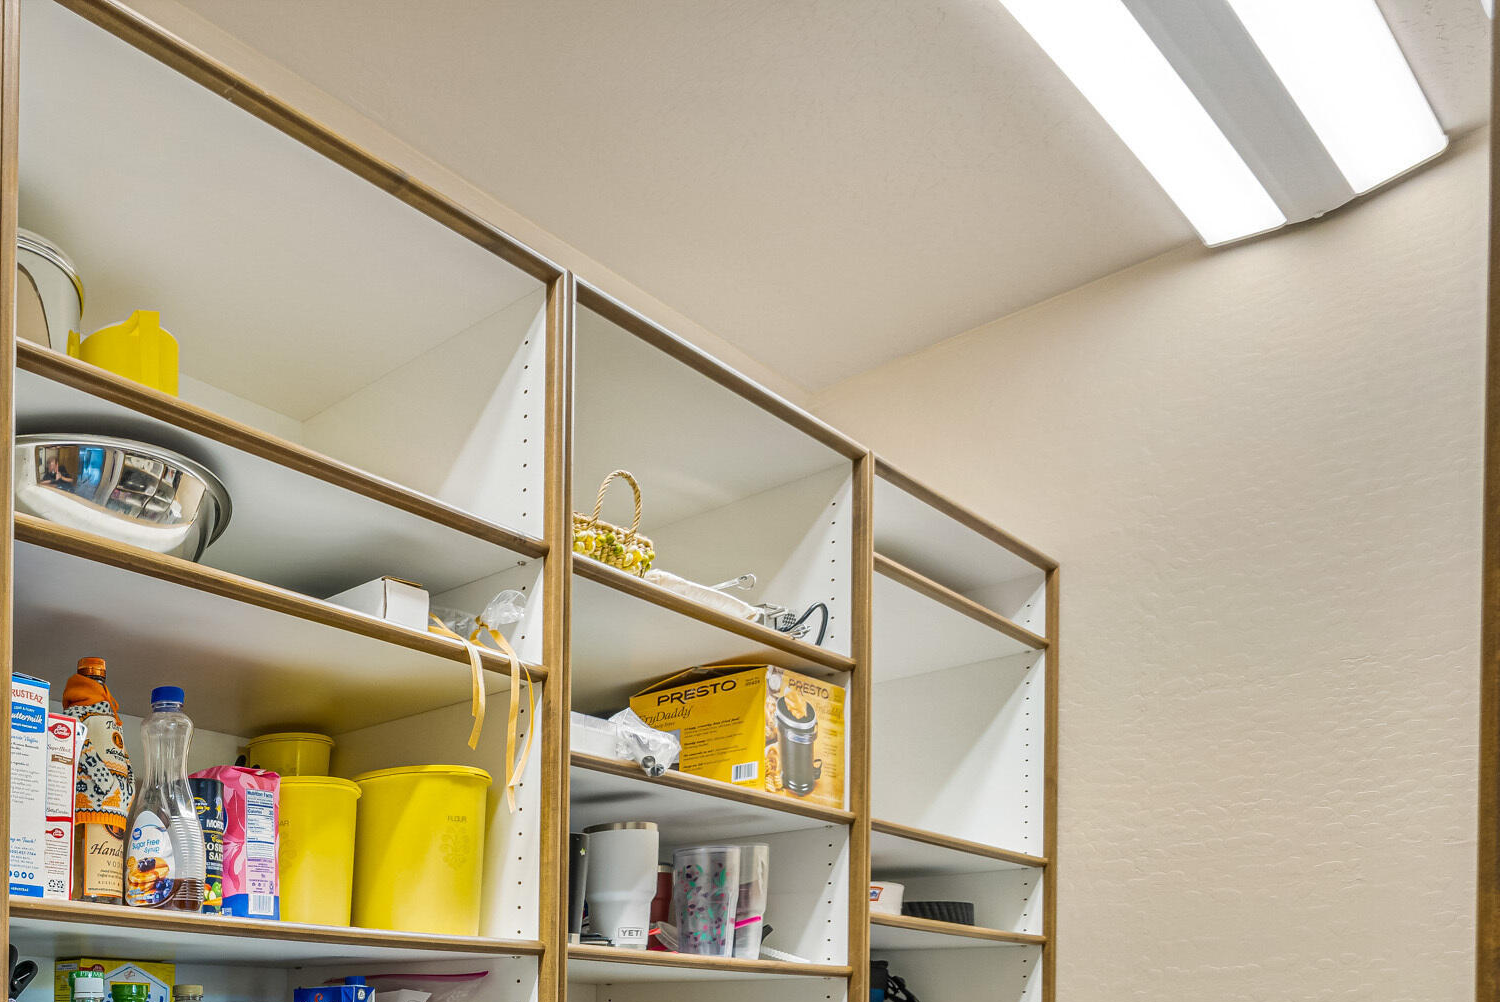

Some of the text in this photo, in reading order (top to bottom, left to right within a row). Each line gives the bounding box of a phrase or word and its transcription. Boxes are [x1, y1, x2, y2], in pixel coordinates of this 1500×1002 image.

[12, 688, 44, 704] RUSTEAZ
[657, 679, 737, 707] PRESTO
[787, 678, 830, 700] PRESTO
[621, 928, 643, 938] YETI
